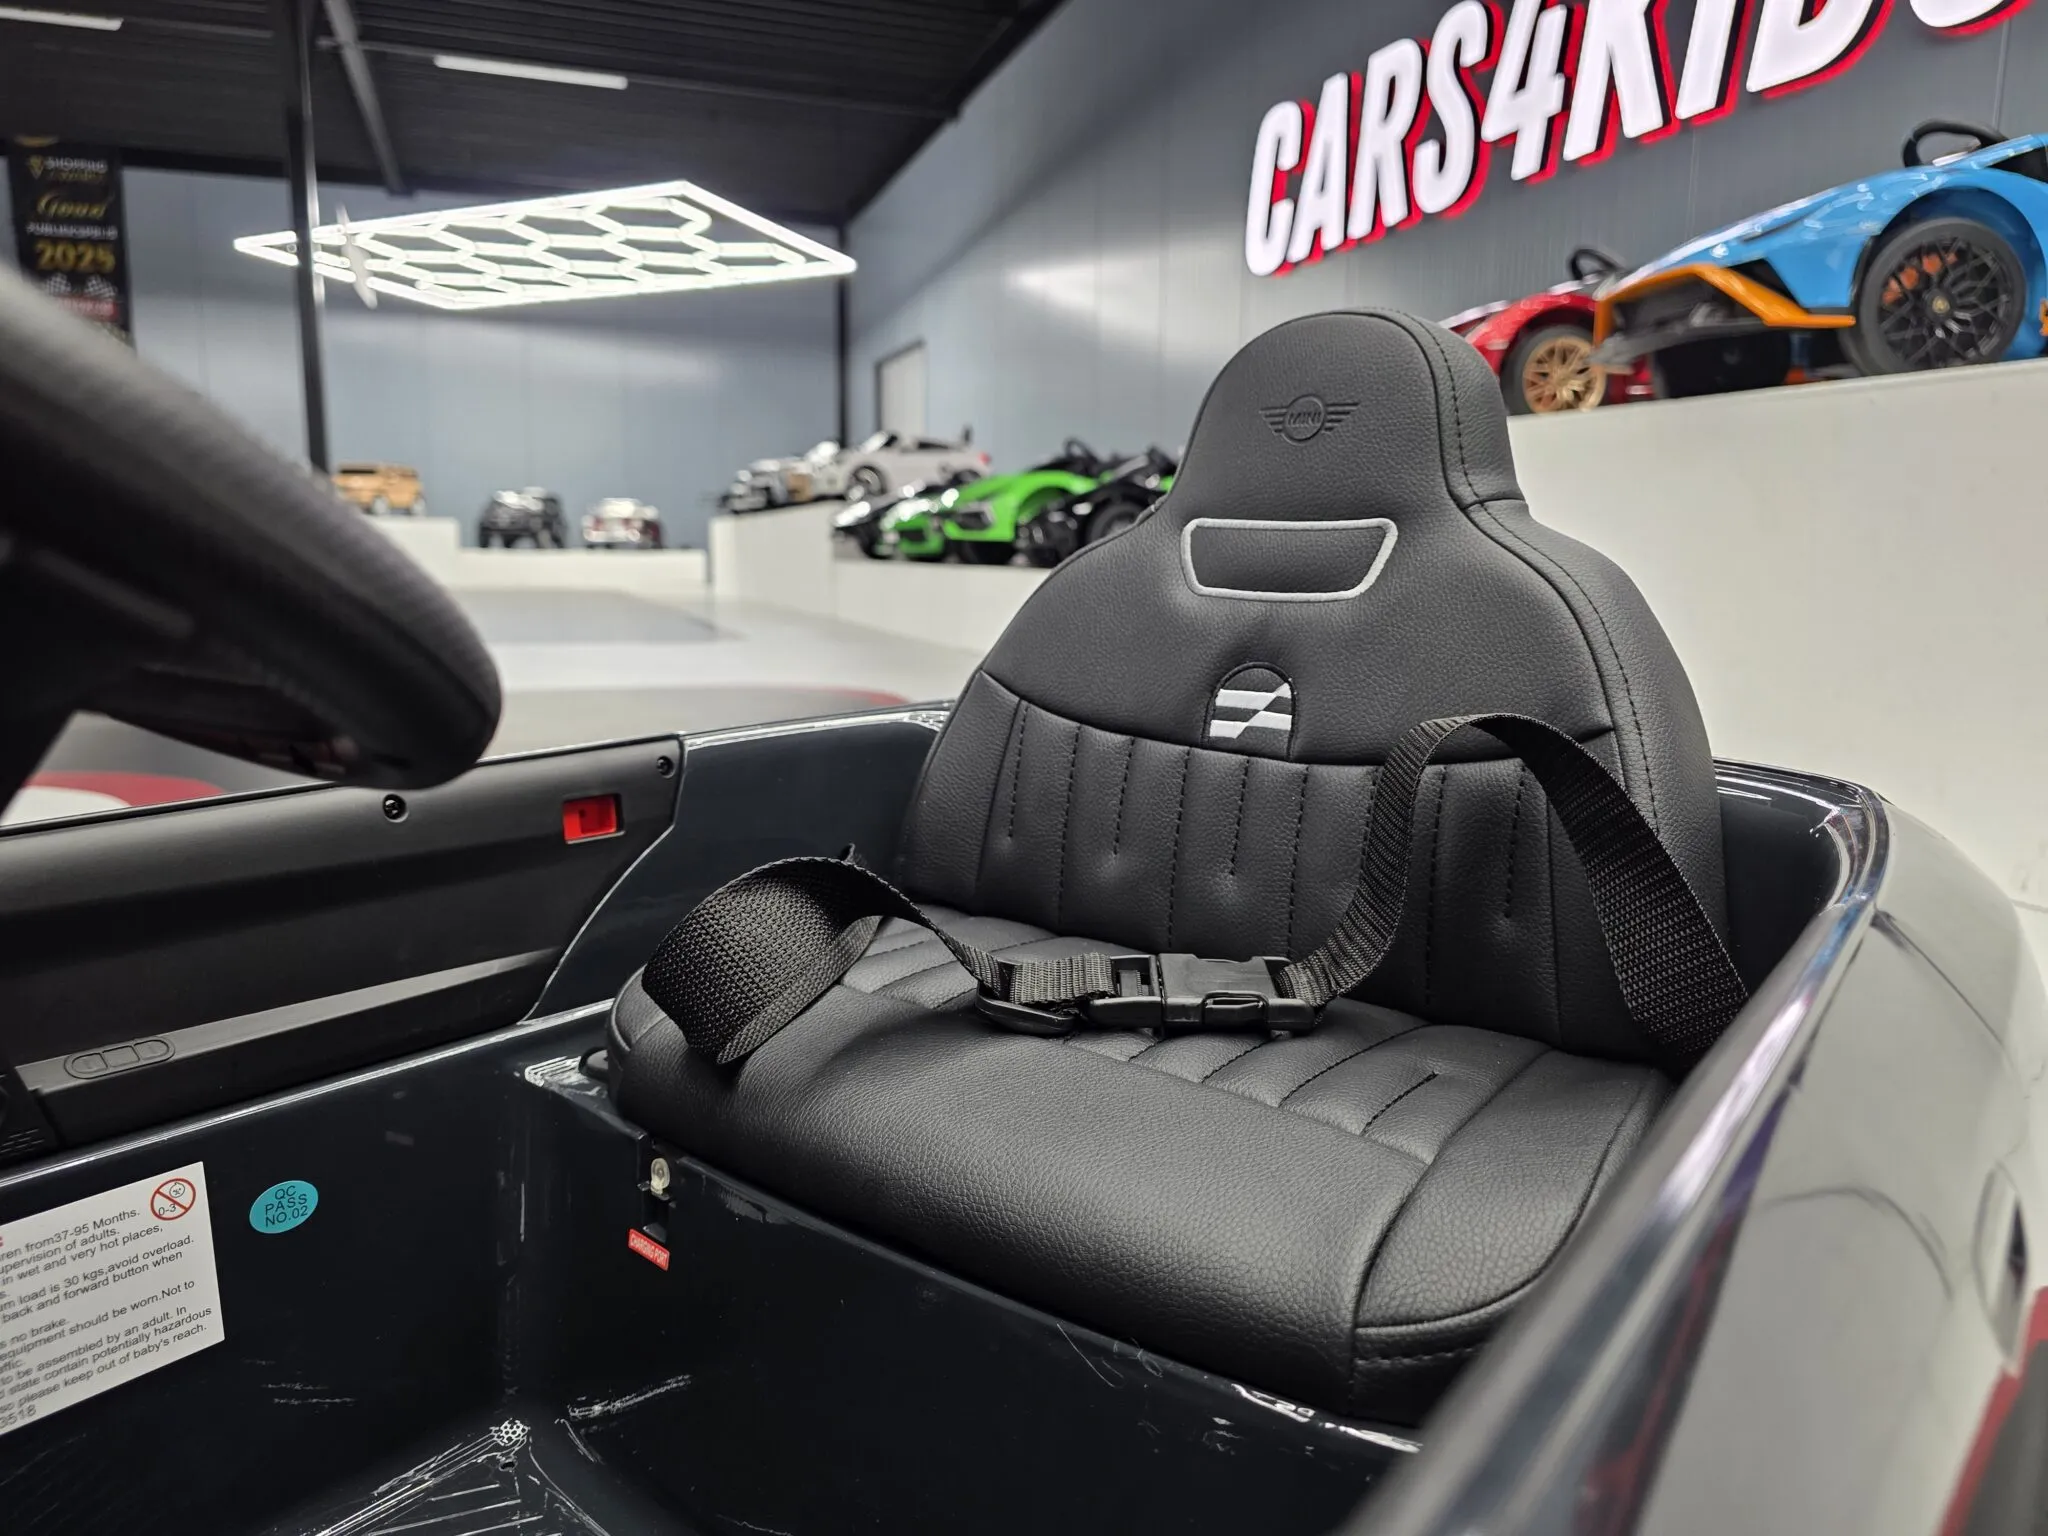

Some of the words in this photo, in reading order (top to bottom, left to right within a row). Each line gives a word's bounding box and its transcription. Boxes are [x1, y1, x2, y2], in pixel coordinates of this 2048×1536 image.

[1245, 0, 2003, 276] CARS4KI
[36, 241, 116, 273] 2025
[1288, 411, 1322, 427] MINI
[158, 1203, 176, 1216] 0-3
[265, 1193, 307, 1215] PASS
[275, 1185, 296, 1200] QC
[25, 1223, 89, 1252] from37-95
[93, 1209, 140, 1230] Months.
[265, 1205, 308, 1227] NO.02
[2, 1276, 14, 1286] in
[17, 1265, 40, 1279] wet
[43, 1256, 67, 1271] and
[70, 1247, 96, 1262] very
[100, 1238, 119, 1252] hot
[122, 1225, 163, 1246] places,
[65, 1239, 77, 1251] of
[81, 1228, 120, 1246] adults.
[654, 1247, 668, 1267] PORT
[2, 1306, 33, 1323] back
[37, 1294, 60, 1310] and
[64, 1277, 109, 1300] forward
[113, 1263, 149, 1283] button
[152, 1251, 183, 1268] when
[19, 1287, 46, 1304] load
[50, 1284, 60, 1293] is
[64, 1275, 79, 1288] 30
[83, 1254, 139, 1281] kgs,avoid
[142, 1235, 194, 1260] overload.
[0, 1329, 66, 1360] equipment
[69, 1312, 109, 1335] should
[112, 1308, 127, 1318] be
[130, 1284, 181, 1311] worn.Not
[184, 1280, 195, 1290] to
[11, 1333, 27, 1344] no
[31, 1318, 69, 1337] brake.
[9, 1377, 40, 1395] state
[44, 1358, 88, 1380] contain
[92, 1332, 151, 1363] potentially
[154, 1307, 212, 1336] hazardous
[17, 1367, 33, 1380] be
[37, 1338, 103, 1371] assembled
[107, 1332, 120, 1344] by
[124, 1326, 139, 1337] an
[142, 1312, 173, 1330] adult.
[176, 1306, 186, 1316] In
[18, 1383, 60, 1407] please
[64, 1370, 93, 1387] keep
[96, 1360, 116, 1373] out
[119, 1352, 131, 1364] of
[133, 1338, 169, 1359] baby's
[173, 1324, 207, 1343] reach.
